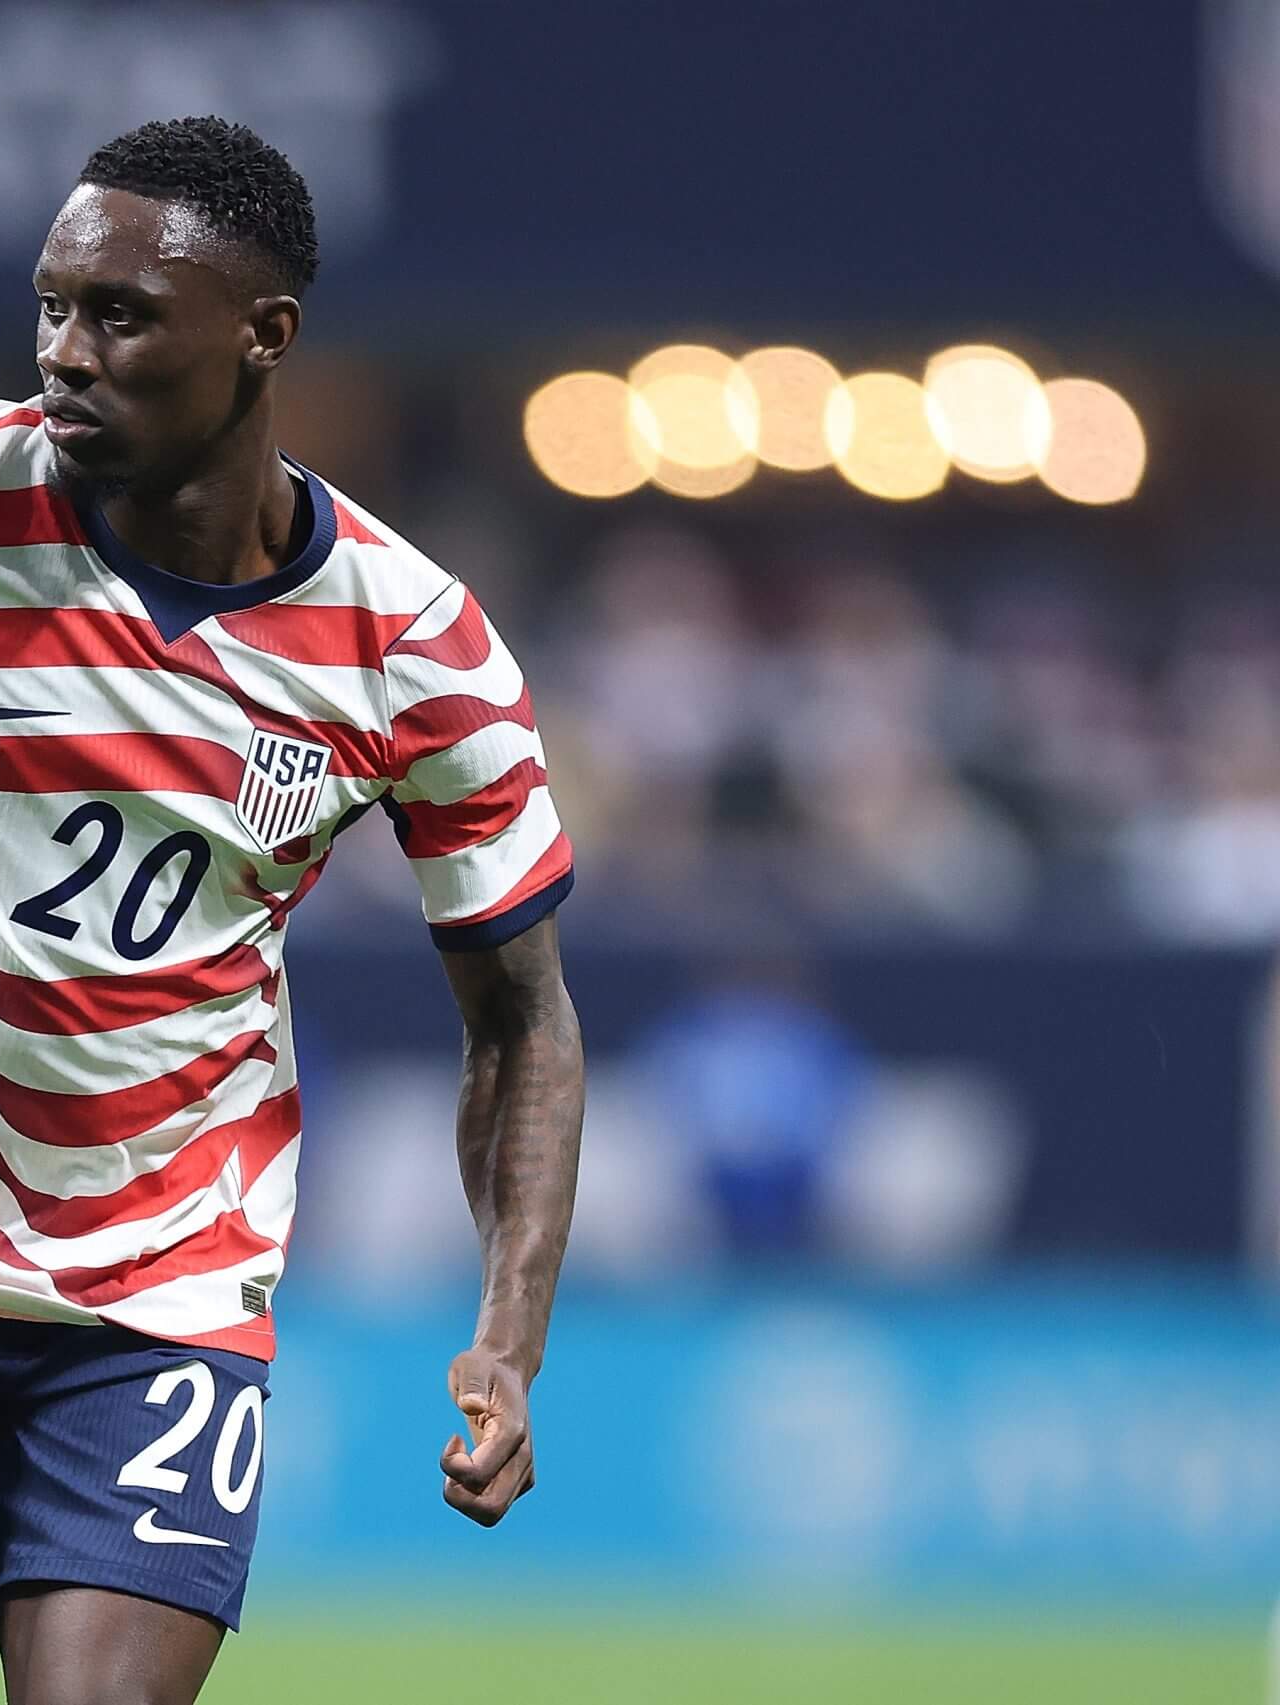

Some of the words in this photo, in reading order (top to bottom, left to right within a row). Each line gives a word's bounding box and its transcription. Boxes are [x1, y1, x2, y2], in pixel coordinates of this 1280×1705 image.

[254, 737, 324, 786] USA
[9, 801, 211, 961] 20
[116, 1360, 263, 1514] 20
